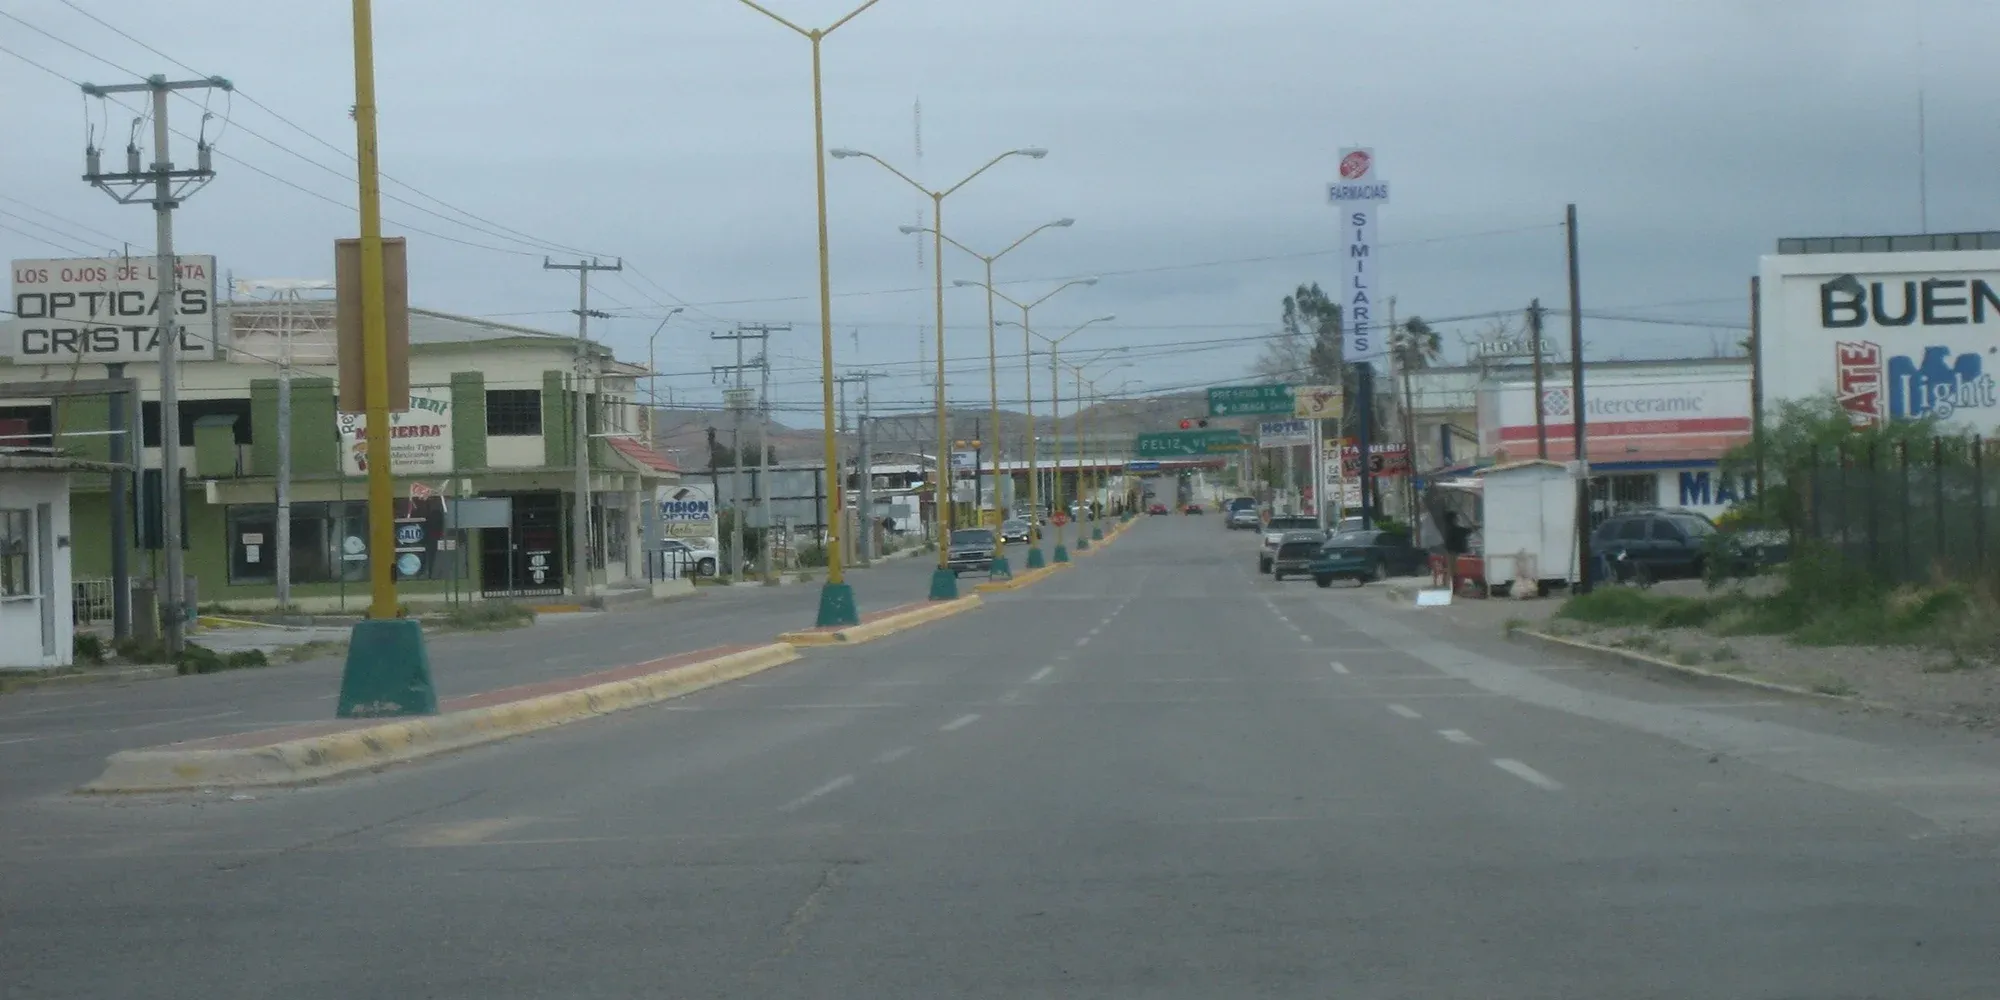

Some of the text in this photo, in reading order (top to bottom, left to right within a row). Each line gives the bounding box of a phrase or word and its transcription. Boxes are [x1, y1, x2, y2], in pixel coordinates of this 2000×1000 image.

[1330, 184, 1388, 201] FARMACIAS
[16, 269, 49, 284] LOS
[61, 267, 108, 283] OJOS
[117, 265, 139, 282] DE
[1350, 212, 1370, 352] SIMILARES
[17, 289, 207, 319] OPTICAS
[1900, 373, 1996, 420] Light
[1262, 421, 1308, 434] HOTEL
[1141, 438, 1181, 450] FELIZ
[660, 500, 709, 513] VISION
[660, 513, 710, 521] OPTICA
